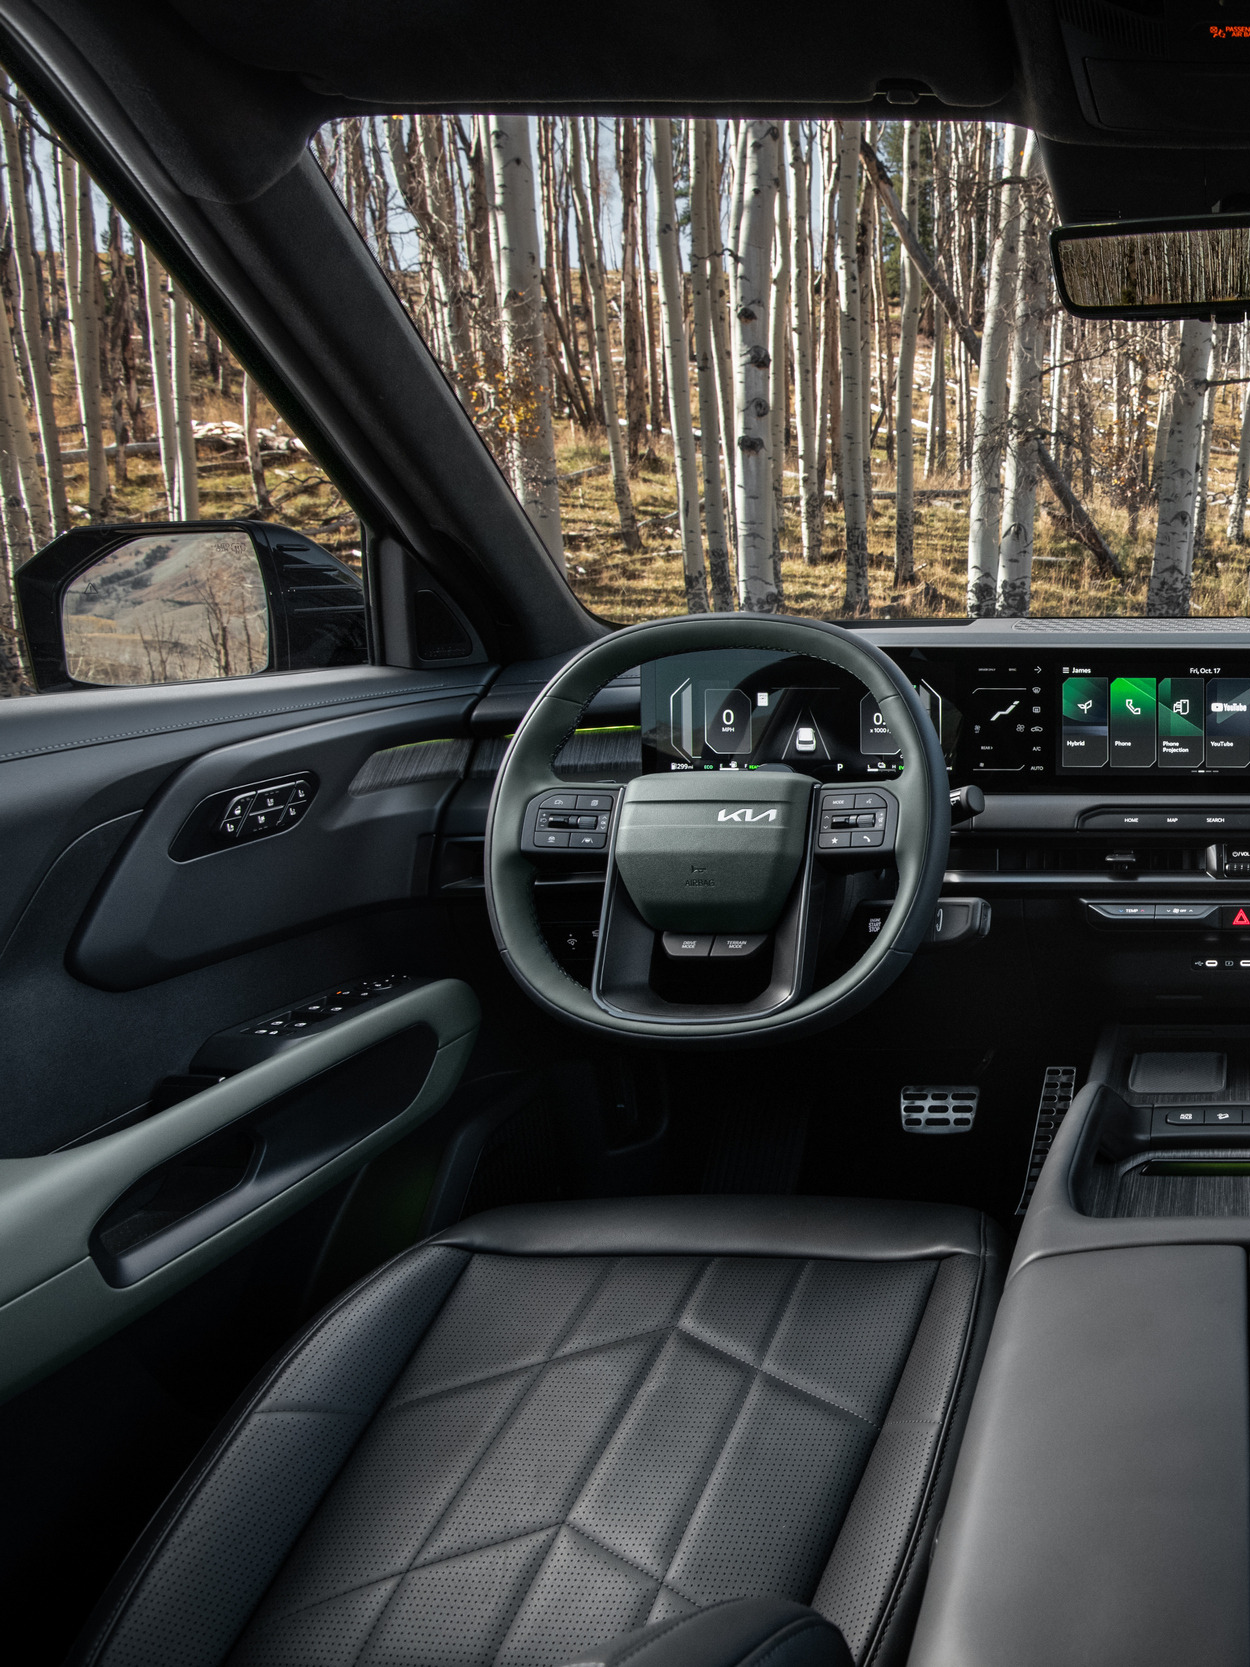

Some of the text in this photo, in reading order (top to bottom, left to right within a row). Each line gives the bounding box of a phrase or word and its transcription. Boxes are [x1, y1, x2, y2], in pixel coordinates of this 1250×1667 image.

[1224, 702, 1247, 712] YouTube
[723, 709, 734, 725] 0
[718, 808, 777, 822] KIA
